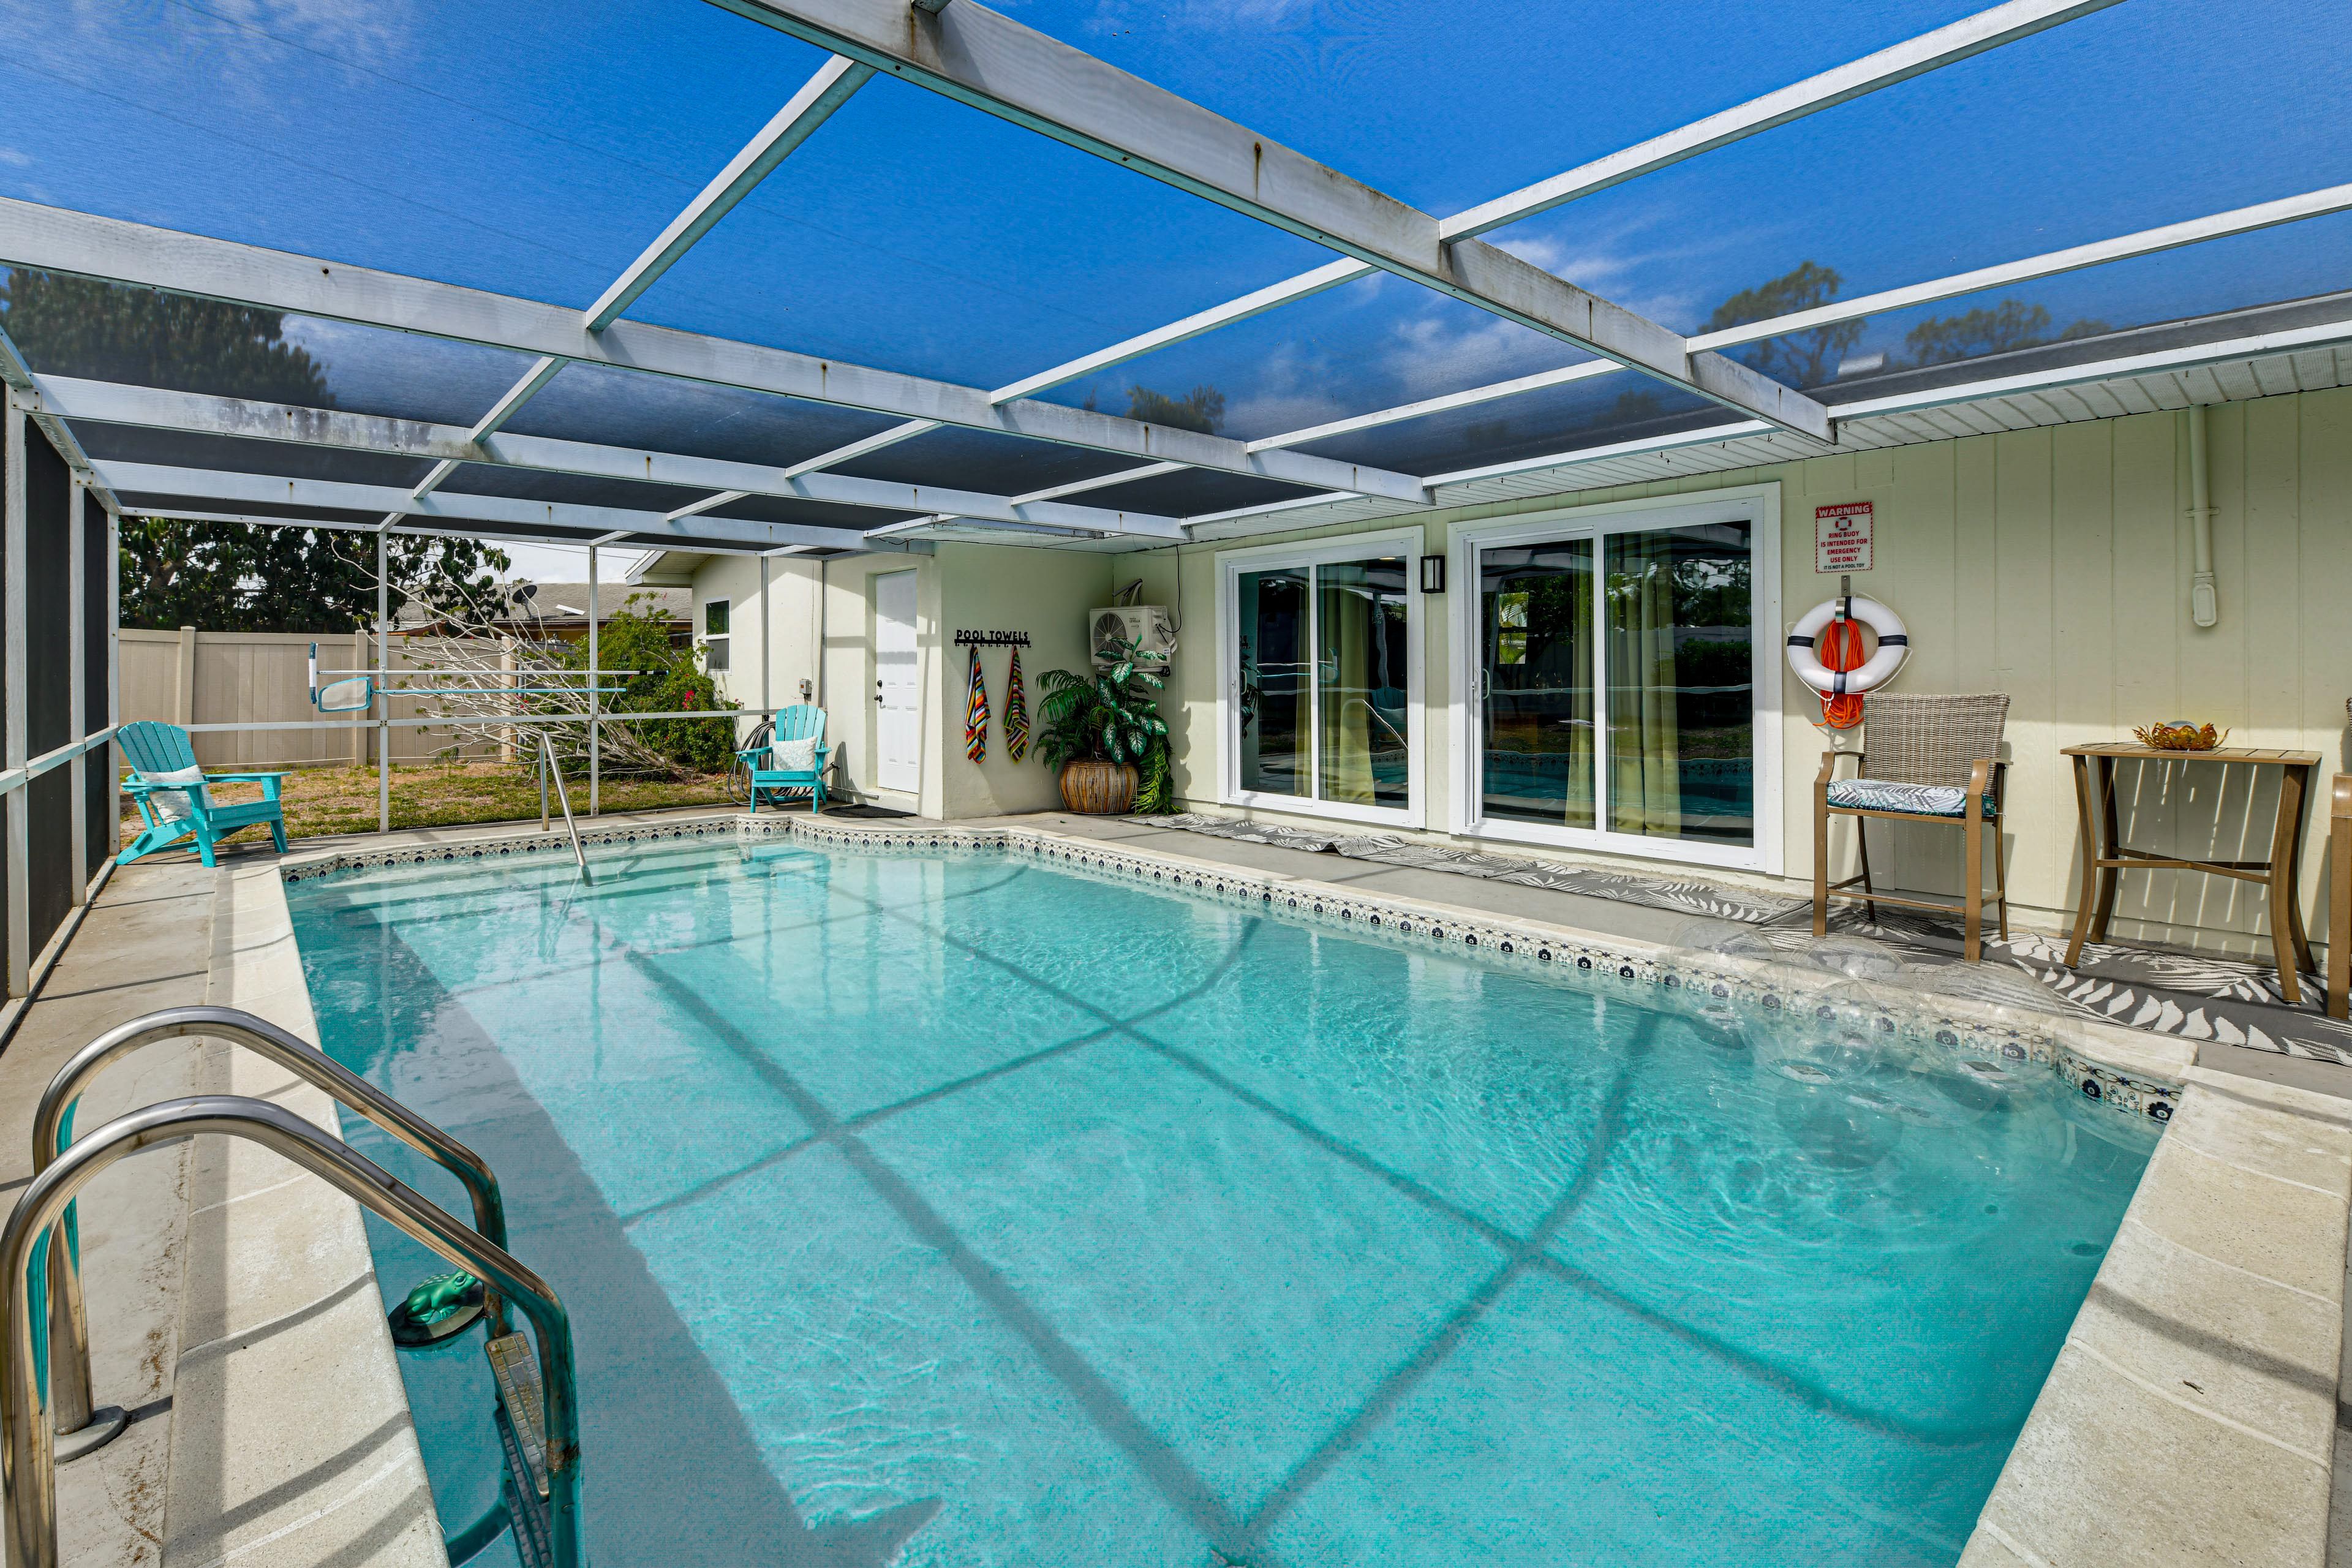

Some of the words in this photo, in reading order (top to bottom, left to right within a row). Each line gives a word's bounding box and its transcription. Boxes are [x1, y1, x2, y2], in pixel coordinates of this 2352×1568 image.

[1818, 505, 1870, 517] WARNING
[956, 629, 986, 640] POOL
[989, 630, 1028, 641] TOWELS
